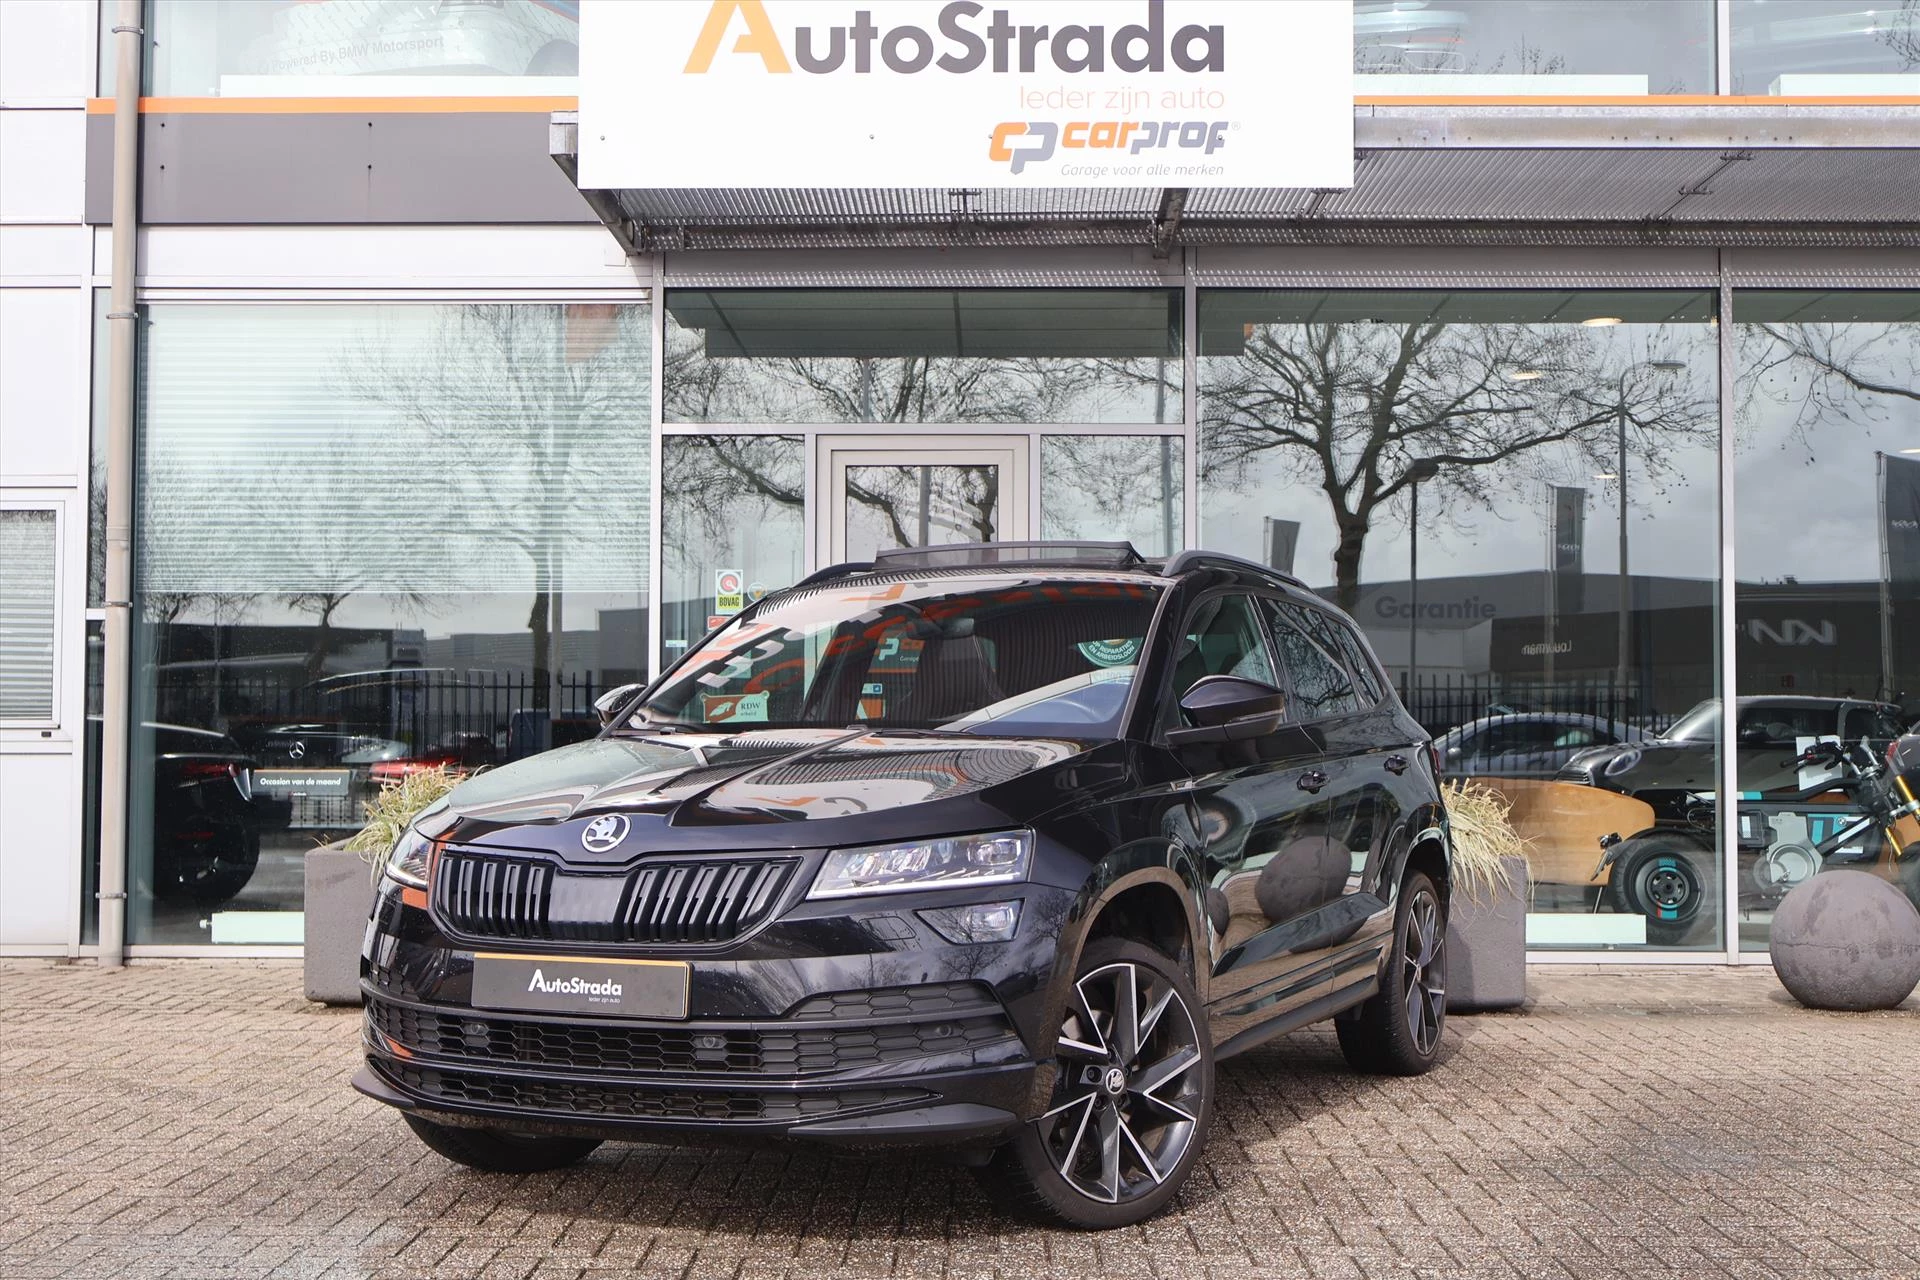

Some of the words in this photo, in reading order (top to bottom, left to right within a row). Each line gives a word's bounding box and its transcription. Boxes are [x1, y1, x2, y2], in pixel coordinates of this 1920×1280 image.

[682, 0, 1225, 74] AutoStrada
[319, 49, 335, 64] By
[338, 43, 369, 60] BMW
[372, 37, 445, 56] Motorsport
[1020, 86, 1096, 110] Ieder
[1104, 86, 1150, 115] zijn
[1161, 89, 1225, 110] auto
[1061, 121, 1230, 155] carprof
[1061, 163, 1109, 179] Garage
[1113, 166, 1143, 176] voor
[1147, 164, 1170, 176] alle
[1174, 164, 1225, 176] merken
[719, 596, 740, 607] BOVAG
[1374, 595, 1497, 620] Garantie
[741, 702, 760, 710] RDW
[260, 777, 291, 786] Occasion
[316, 777, 342, 786] maand
[528, 968, 622, 996] AutoStrada
